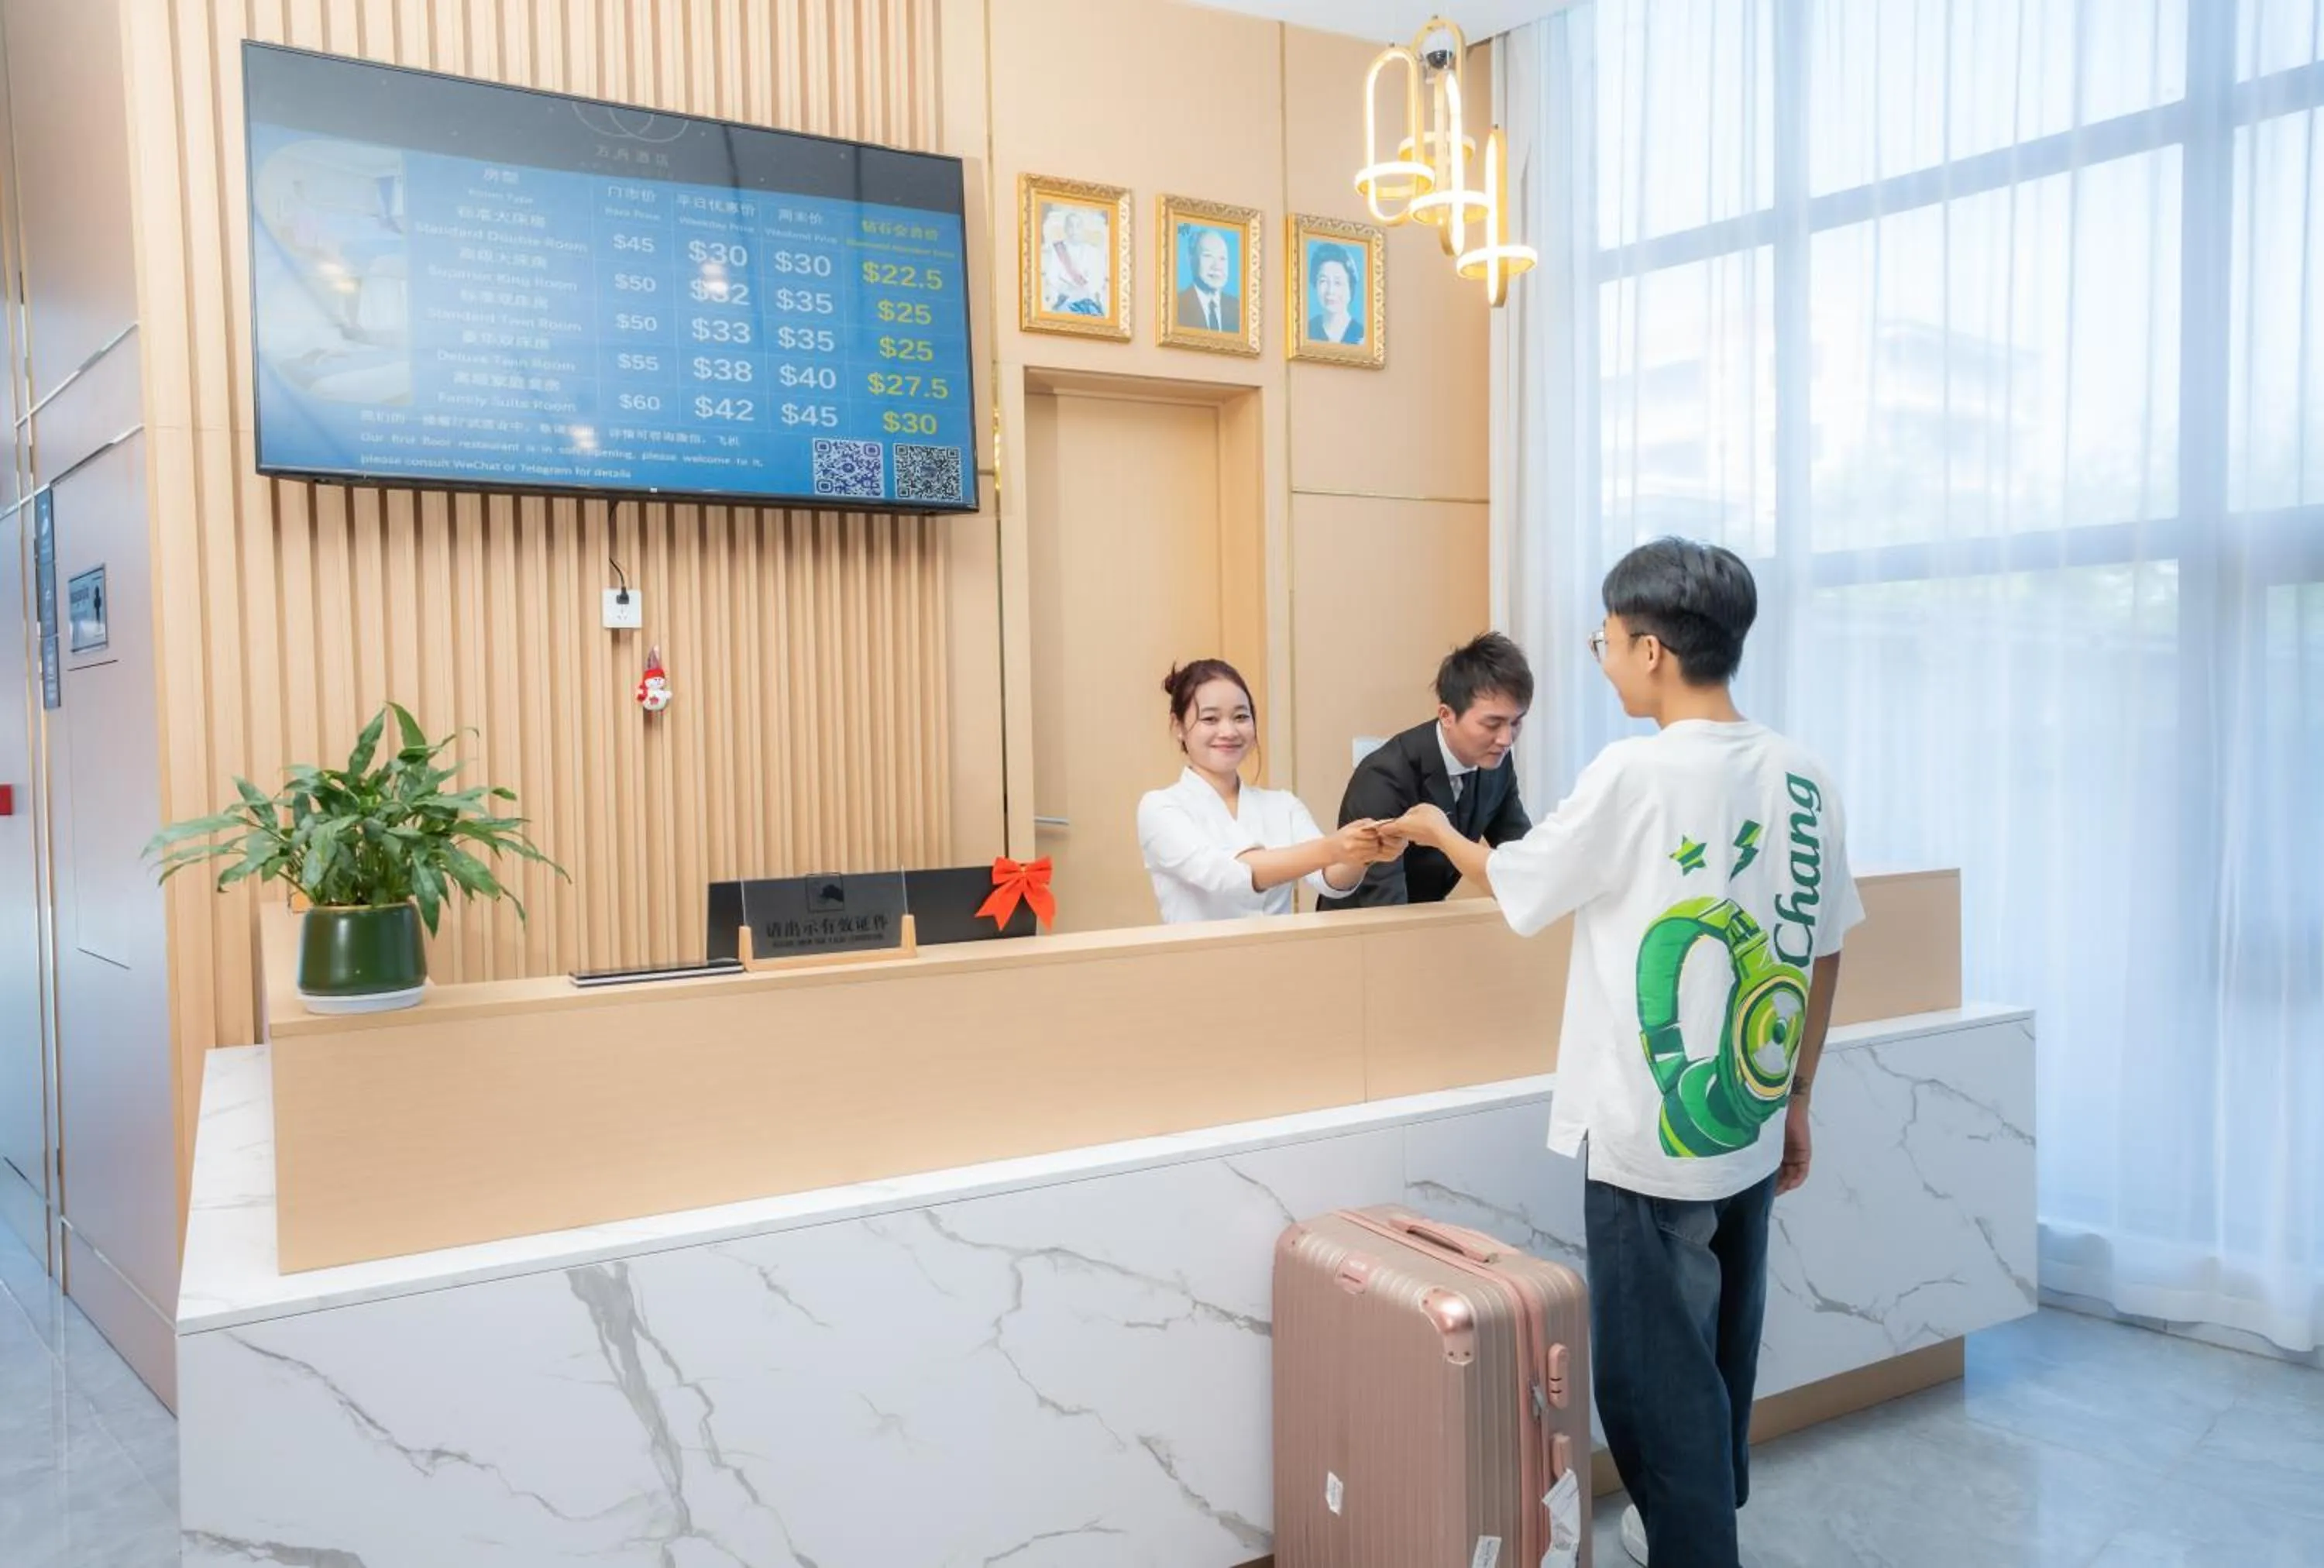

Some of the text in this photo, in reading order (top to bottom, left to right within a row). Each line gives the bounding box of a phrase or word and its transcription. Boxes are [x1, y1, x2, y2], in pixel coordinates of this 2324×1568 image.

[545, 236, 589, 253] Room
[613, 234, 655, 254] $45
[688, 239, 748, 266] $30
[775, 250, 831, 277] $30
[861, 261, 943, 291] $22.5
[614, 272, 656, 293] $50
[775, 287, 833, 315] $35
[877, 299, 932, 325] $25
[615, 312, 658, 332] $50
[692, 316, 751, 344] $33
[777, 325, 834, 352] $35
[878, 335, 933, 362] $25
[618, 352, 659, 372] $55
[693, 356, 752, 383] $38
[779, 362, 837, 390] $40
[867, 372, 948, 400] $27.5
[618, 393, 661, 412] $60
[695, 394, 755, 422] $42
[781, 402, 838, 428] $45
[883, 411, 937, 435] $30
[361, 453, 401, 466] please
[453, 459, 501, 471] WeChat
[682, 454, 731, 466] welcome
[1773, 771, 1822, 969] Chang
